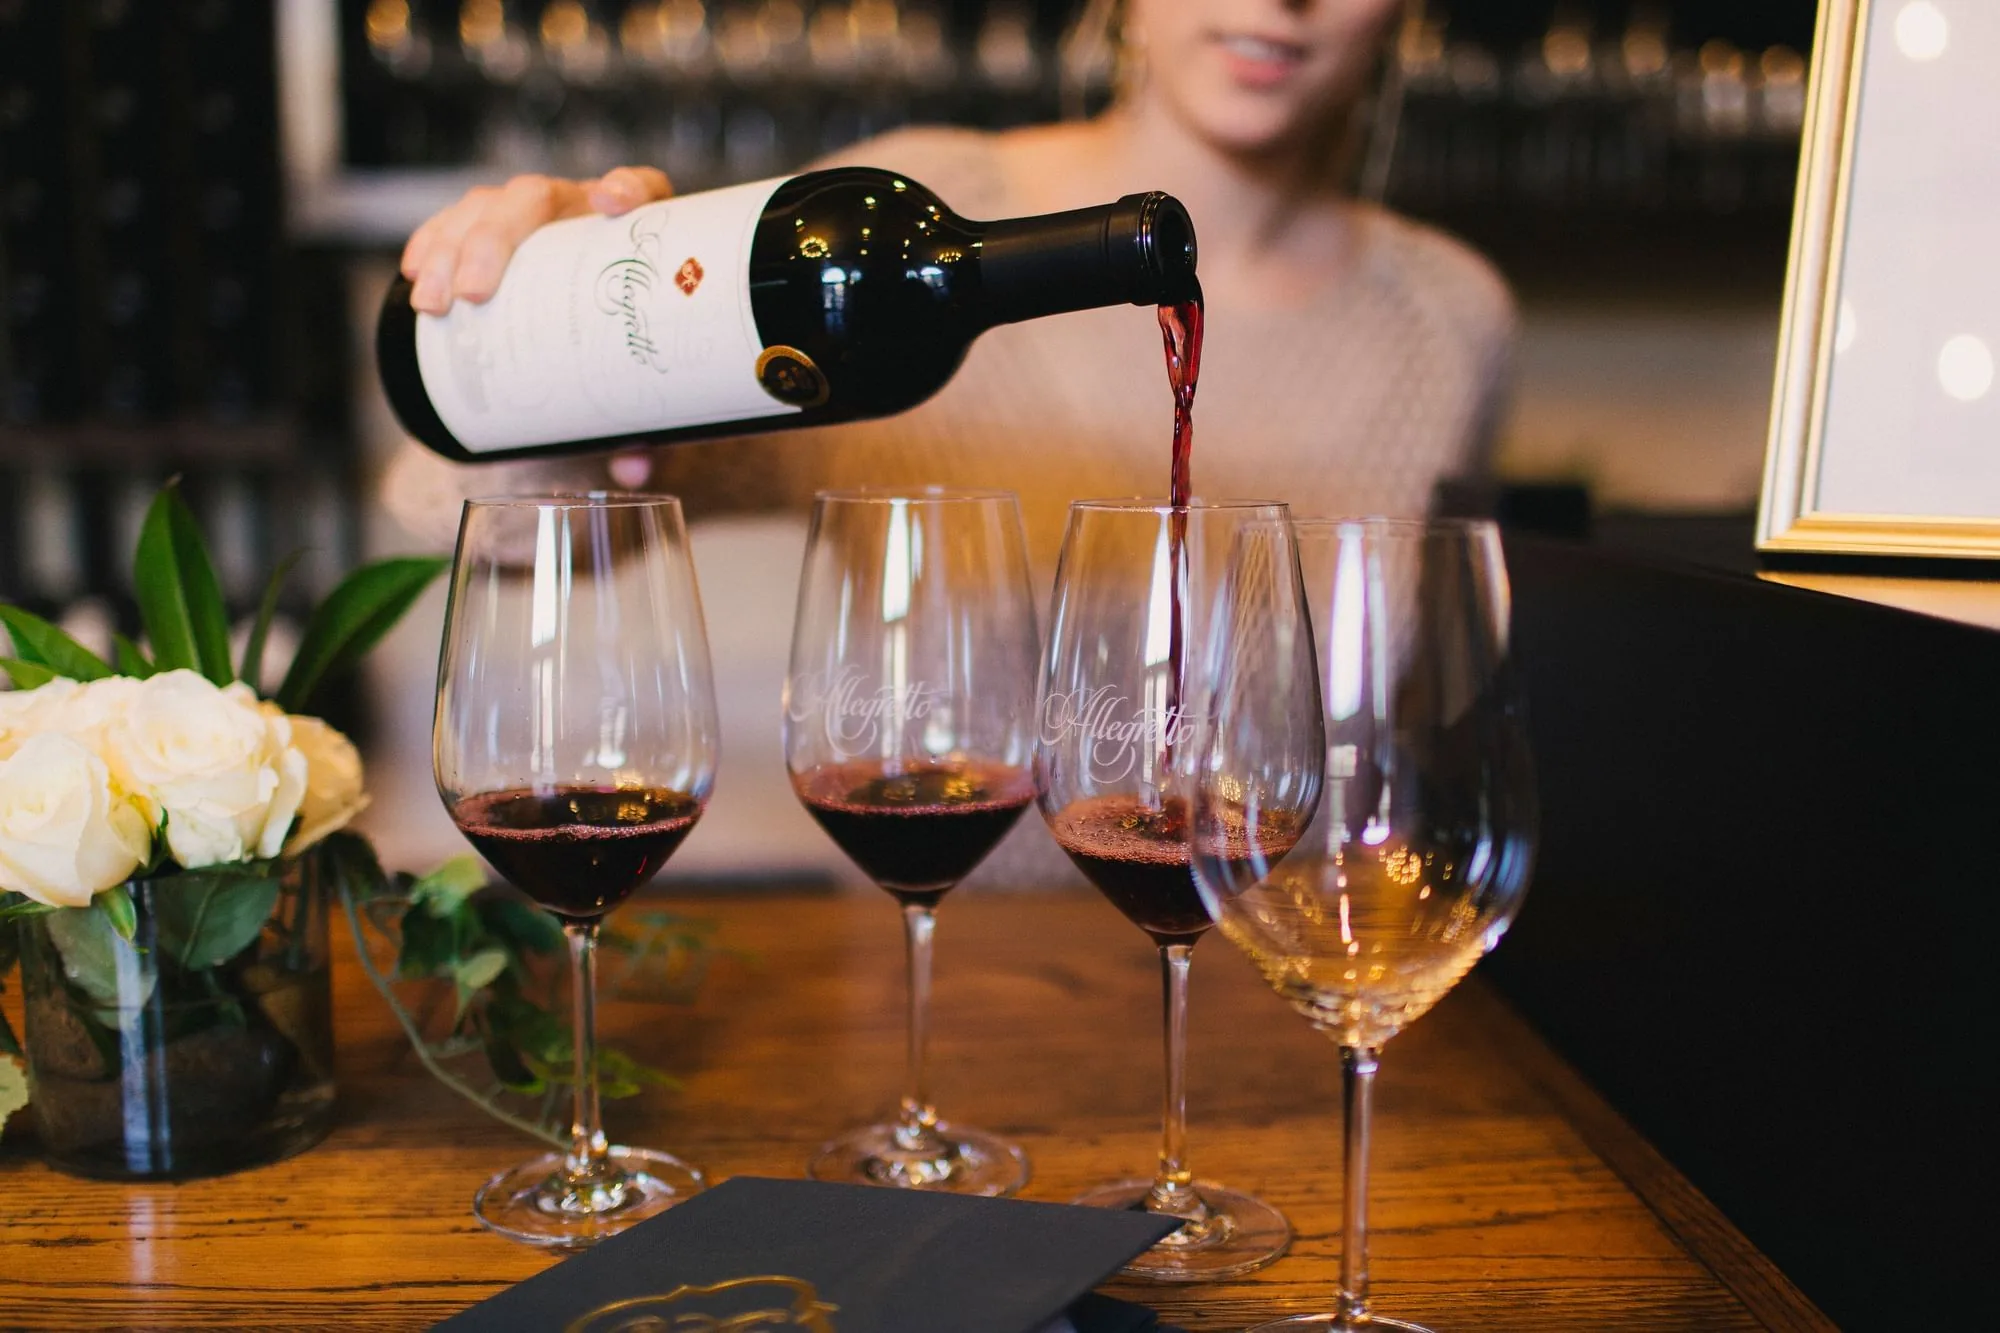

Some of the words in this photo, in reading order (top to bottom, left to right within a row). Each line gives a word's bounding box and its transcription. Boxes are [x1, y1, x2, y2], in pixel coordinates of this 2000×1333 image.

[594, 206, 669, 375] Allegretto
[789, 663, 950, 757] Allegretto
[1039, 683, 1199, 784] Allegretto
